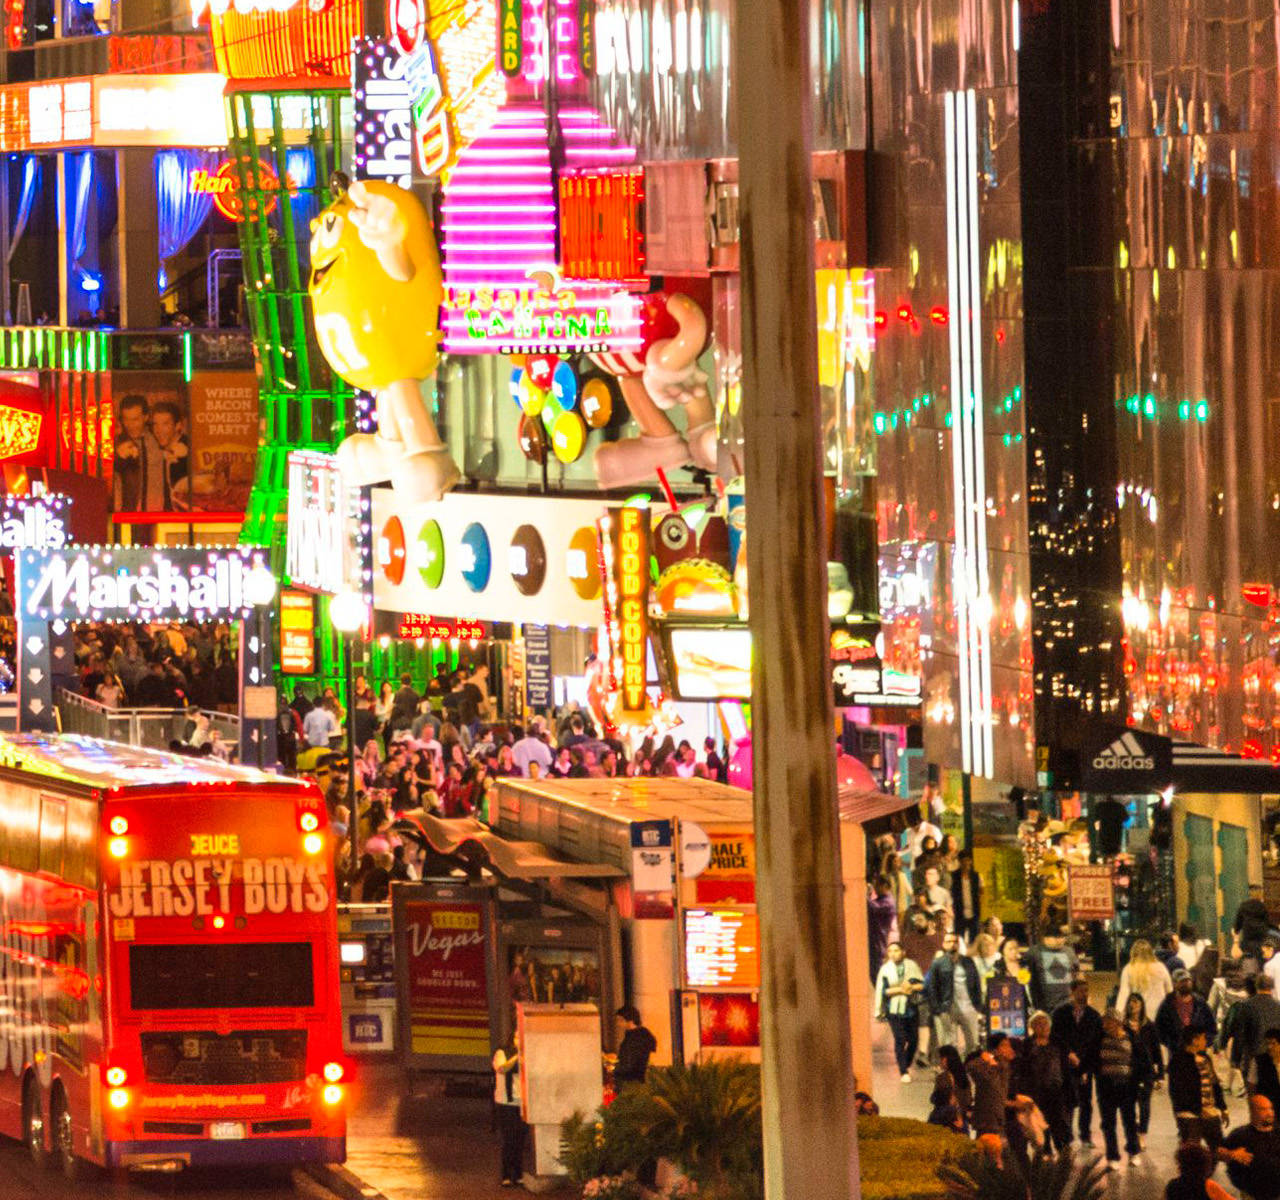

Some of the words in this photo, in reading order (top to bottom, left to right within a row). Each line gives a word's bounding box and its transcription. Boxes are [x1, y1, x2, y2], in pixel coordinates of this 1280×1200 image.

[205, 388, 253, 399] WHERE
[205, 400, 252, 410] BACON
[195, 412, 241, 423] COMES
[208, 424, 251, 435] PARTY
[622, 511, 641, 595] FOOD
[622, 600, 642, 709] COURT
[1092, 756, 1155, 770] adidas
[708, 856, 747, 869] PRICE
[109, 858, 234, 917] JERSEY
[242, 855, 330, 915] BOYS
[406, 922, 486, 962] Vegas
